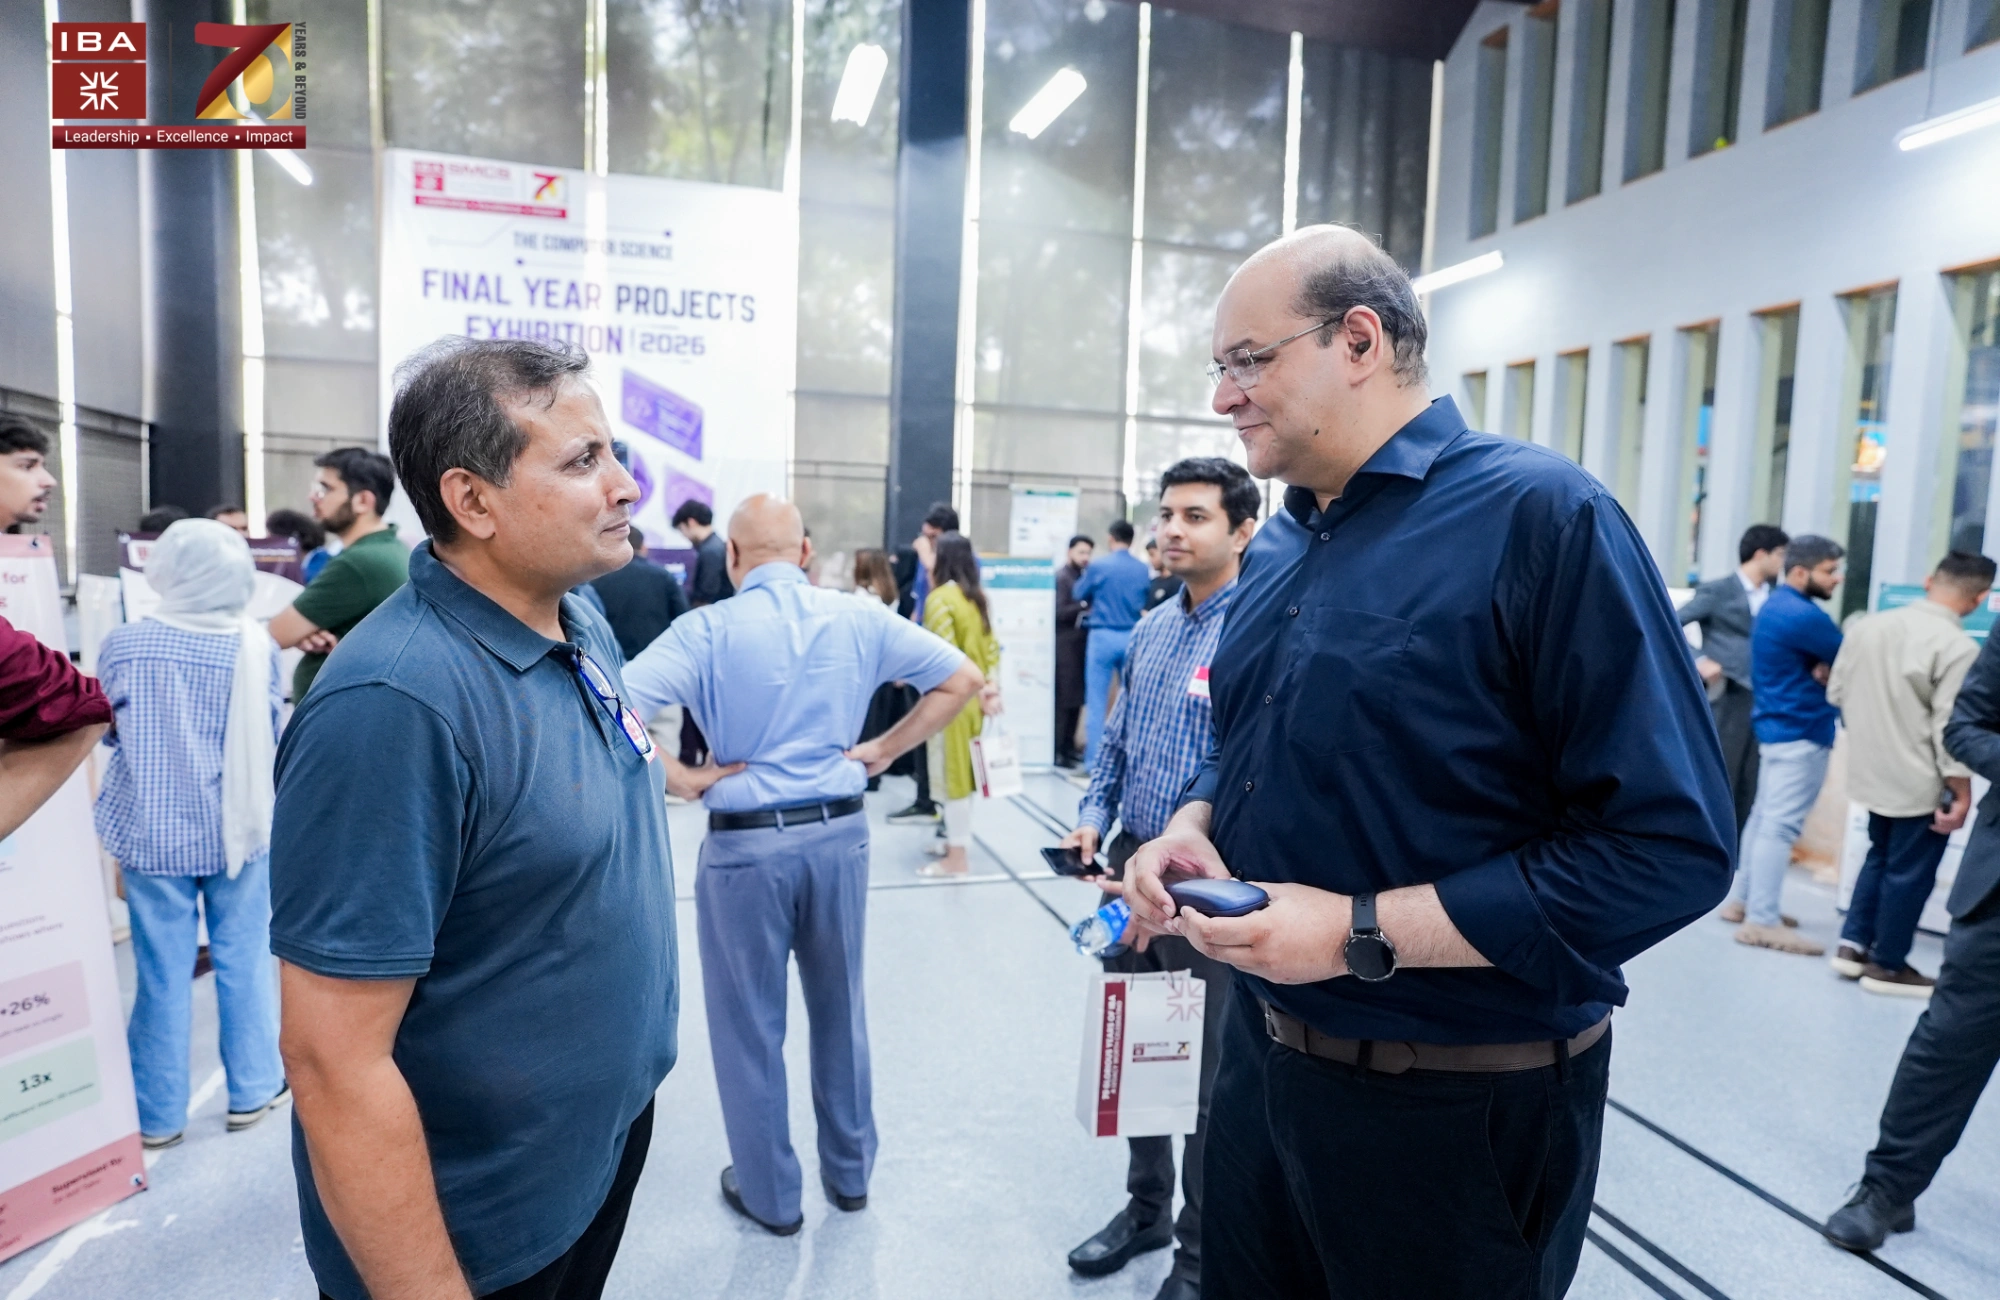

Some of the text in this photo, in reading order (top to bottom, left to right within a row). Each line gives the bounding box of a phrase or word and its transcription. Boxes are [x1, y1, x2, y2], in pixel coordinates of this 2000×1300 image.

[513, 231, 537, 249] THE
[620, 239, 673, 261] SCIENCE
[422, 268, 756, 323] FINAL YEAR PROJECTS
[640, 332, 706, 356] 2026
[3, 570, 29, 585] for
[1107, 1010, 1115, 1022] OF
[1105, 1022, 1115, 1048] YEARS
[19, 1072, 52, 1094] 13x
